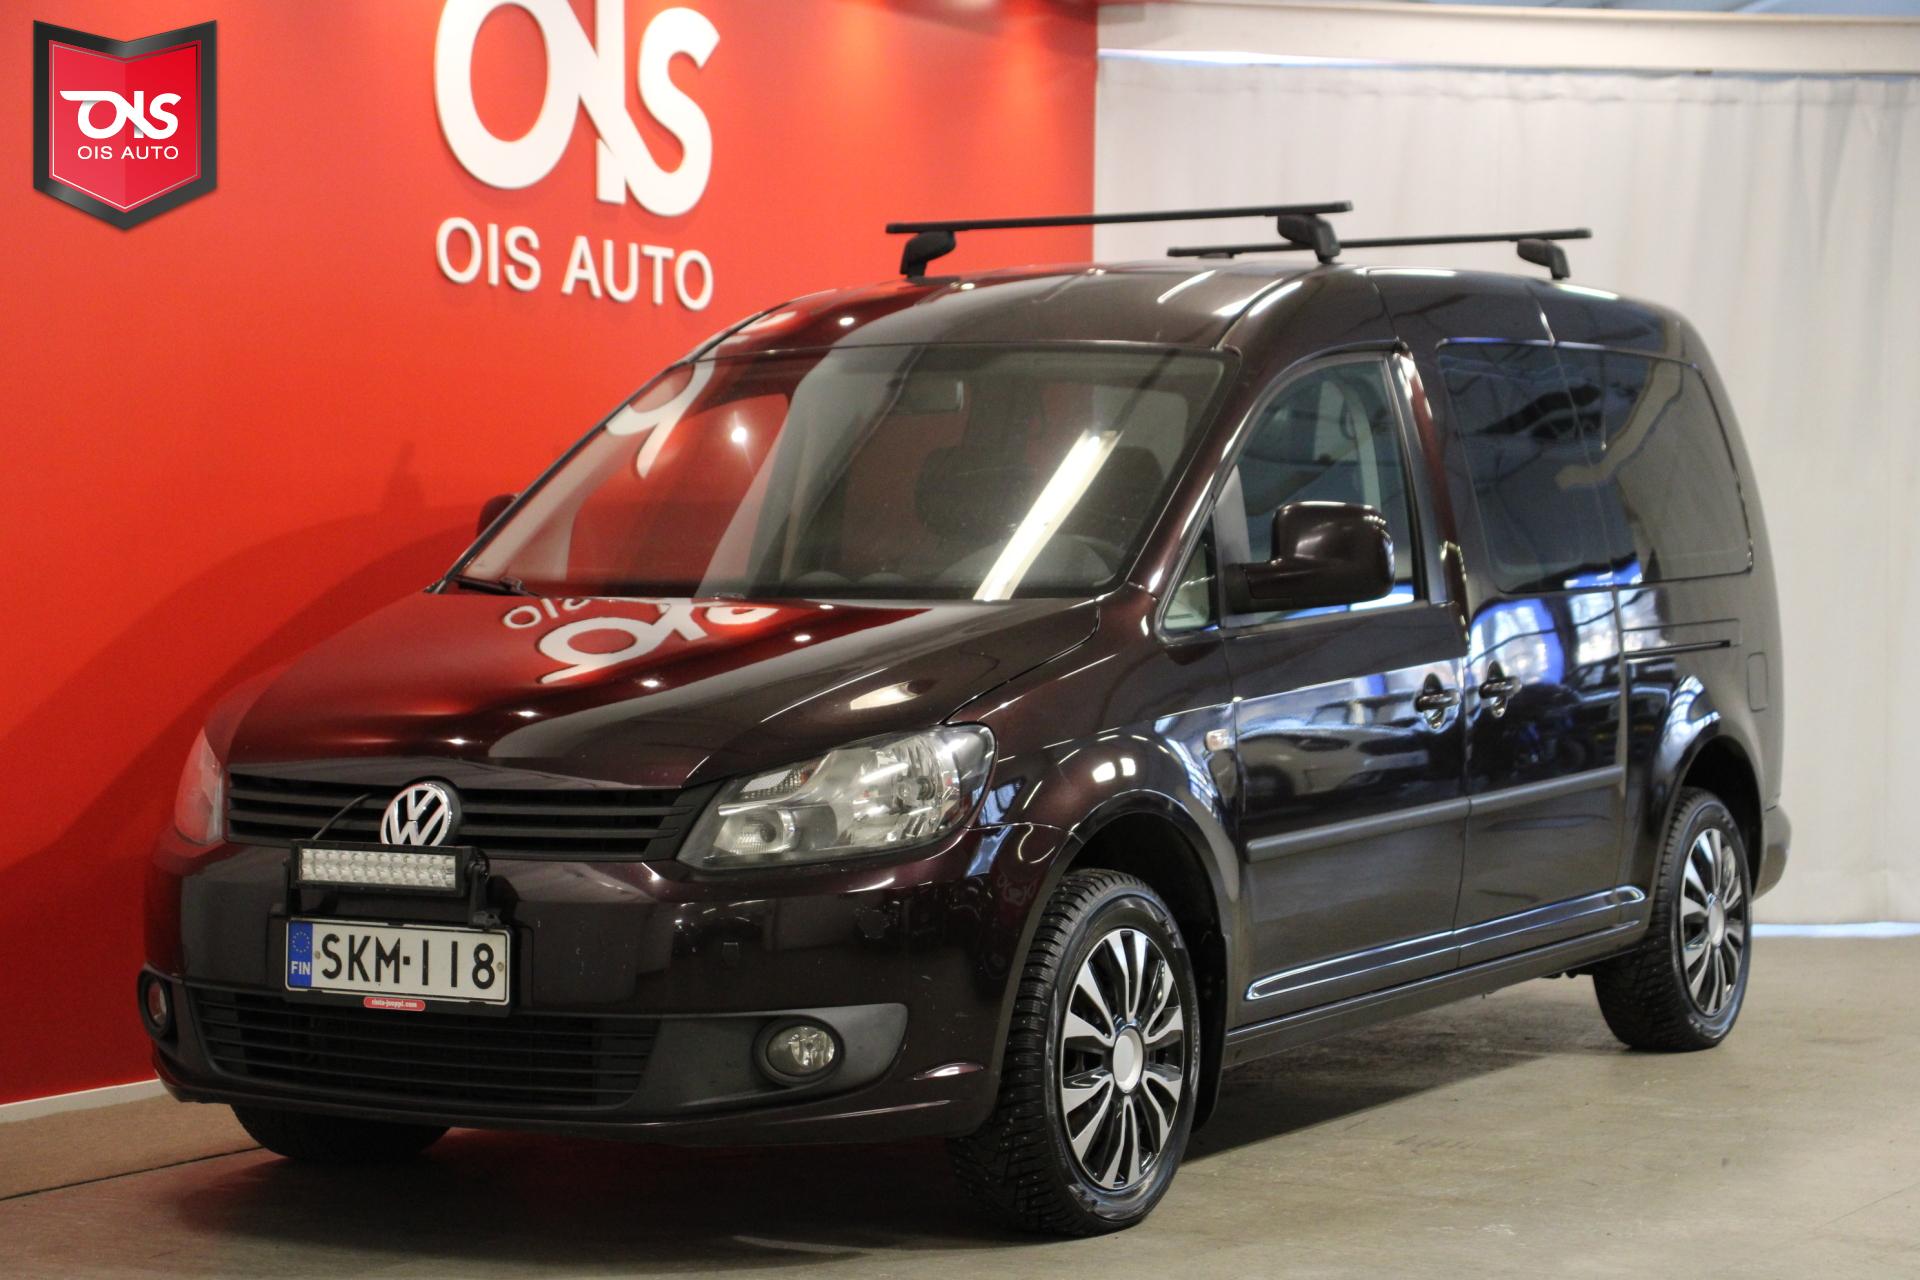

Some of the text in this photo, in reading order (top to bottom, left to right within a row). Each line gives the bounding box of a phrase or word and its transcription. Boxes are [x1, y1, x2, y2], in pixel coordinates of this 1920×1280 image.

[436, 216, 714, 310] OIS AUTO
[291, 960, 311, 976] FIN
[321, 933, 496, 990] SKM-118
